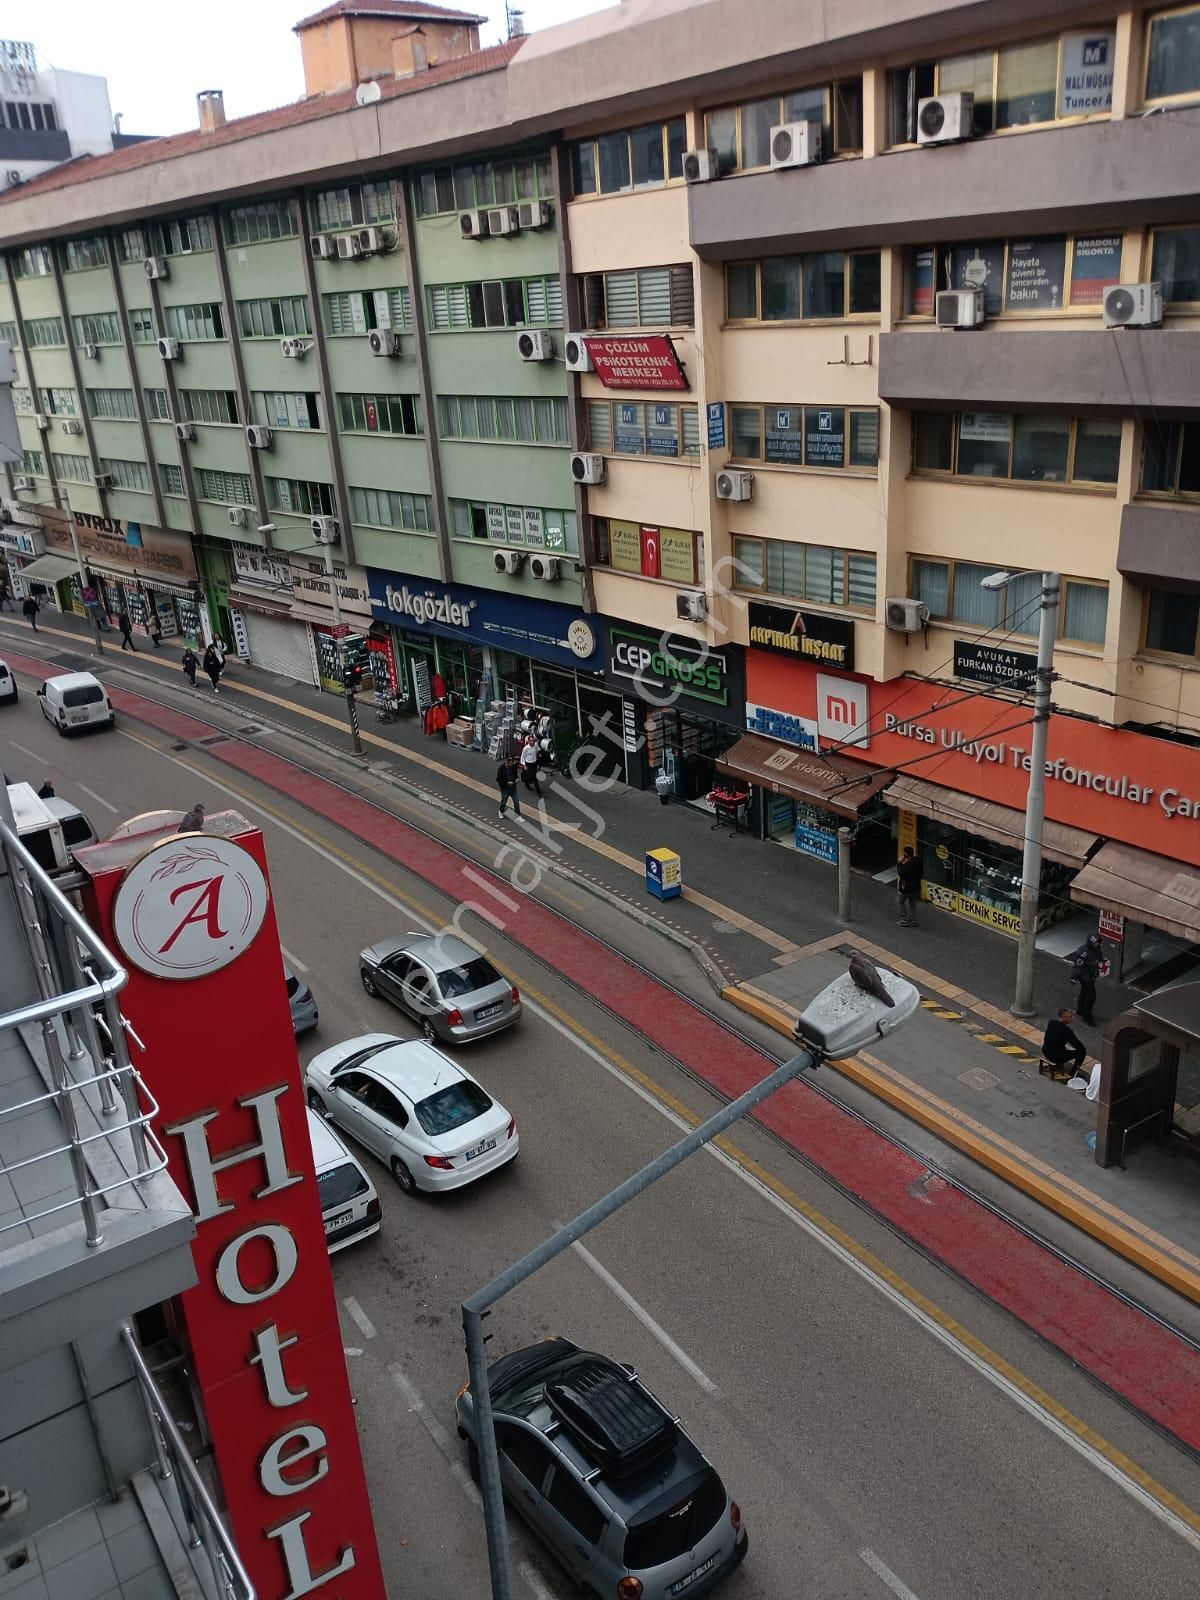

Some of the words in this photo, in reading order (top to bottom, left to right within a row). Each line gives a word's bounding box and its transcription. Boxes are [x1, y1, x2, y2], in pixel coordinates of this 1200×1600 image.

[1065, 96, 1102, 109] Tuncer
[1077, 239, 1120, 248] ANADOLU
[1011, 257, 1040, 269] Hayata
[1011, 270, 1036, 281] güvenli
[1036, 269, 1046, 277] bir
[1010, 278, 1049, 288] pencereden
[1010, 288, 1038, 301] bakın
[605, 340, 650, 355] ÇÖZÜM
[385, 584, 470, 626] tokgözler
[750, 626, 800, 652] AKPINAR
[801, 634, 847, 662] İNŞAAT
[957, 657, 993, 673] FURKAN
[976, 650, 1018, 665] AVUKAT
[885, 713, 936, 745] Bursa
[1009, 746, 1154, 805] Teefoncular
[960, 898, 990, 920] TEKNİK
[992, 911, 1021, 933] SERVİS
